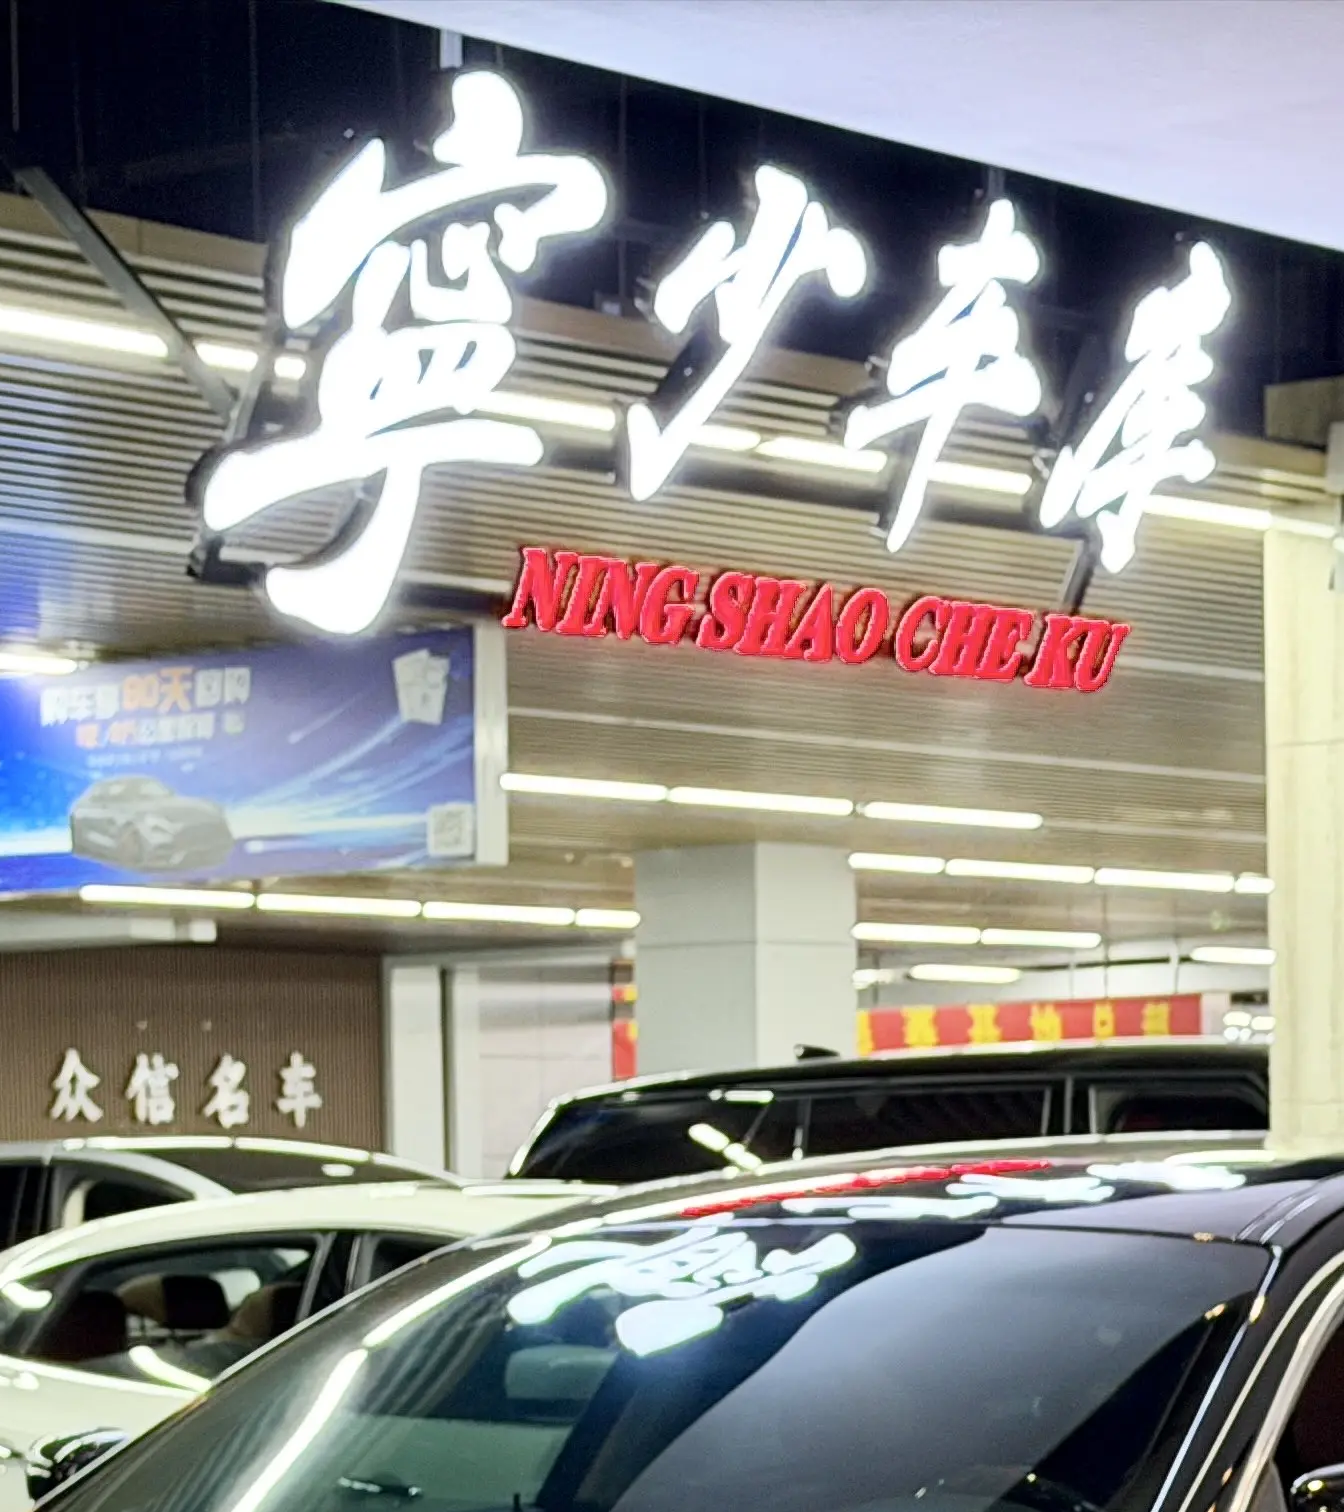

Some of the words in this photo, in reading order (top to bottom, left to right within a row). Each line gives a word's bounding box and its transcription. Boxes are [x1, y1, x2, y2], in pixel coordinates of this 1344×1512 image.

[502, 546, 700, 646] NING
[695, 569, 891, 665] SHAO
[895, 595, 1037, 683] CHE
[1024, 613, 1132, 693] KU
[49, 1047, 323, 1129] 众信名车
